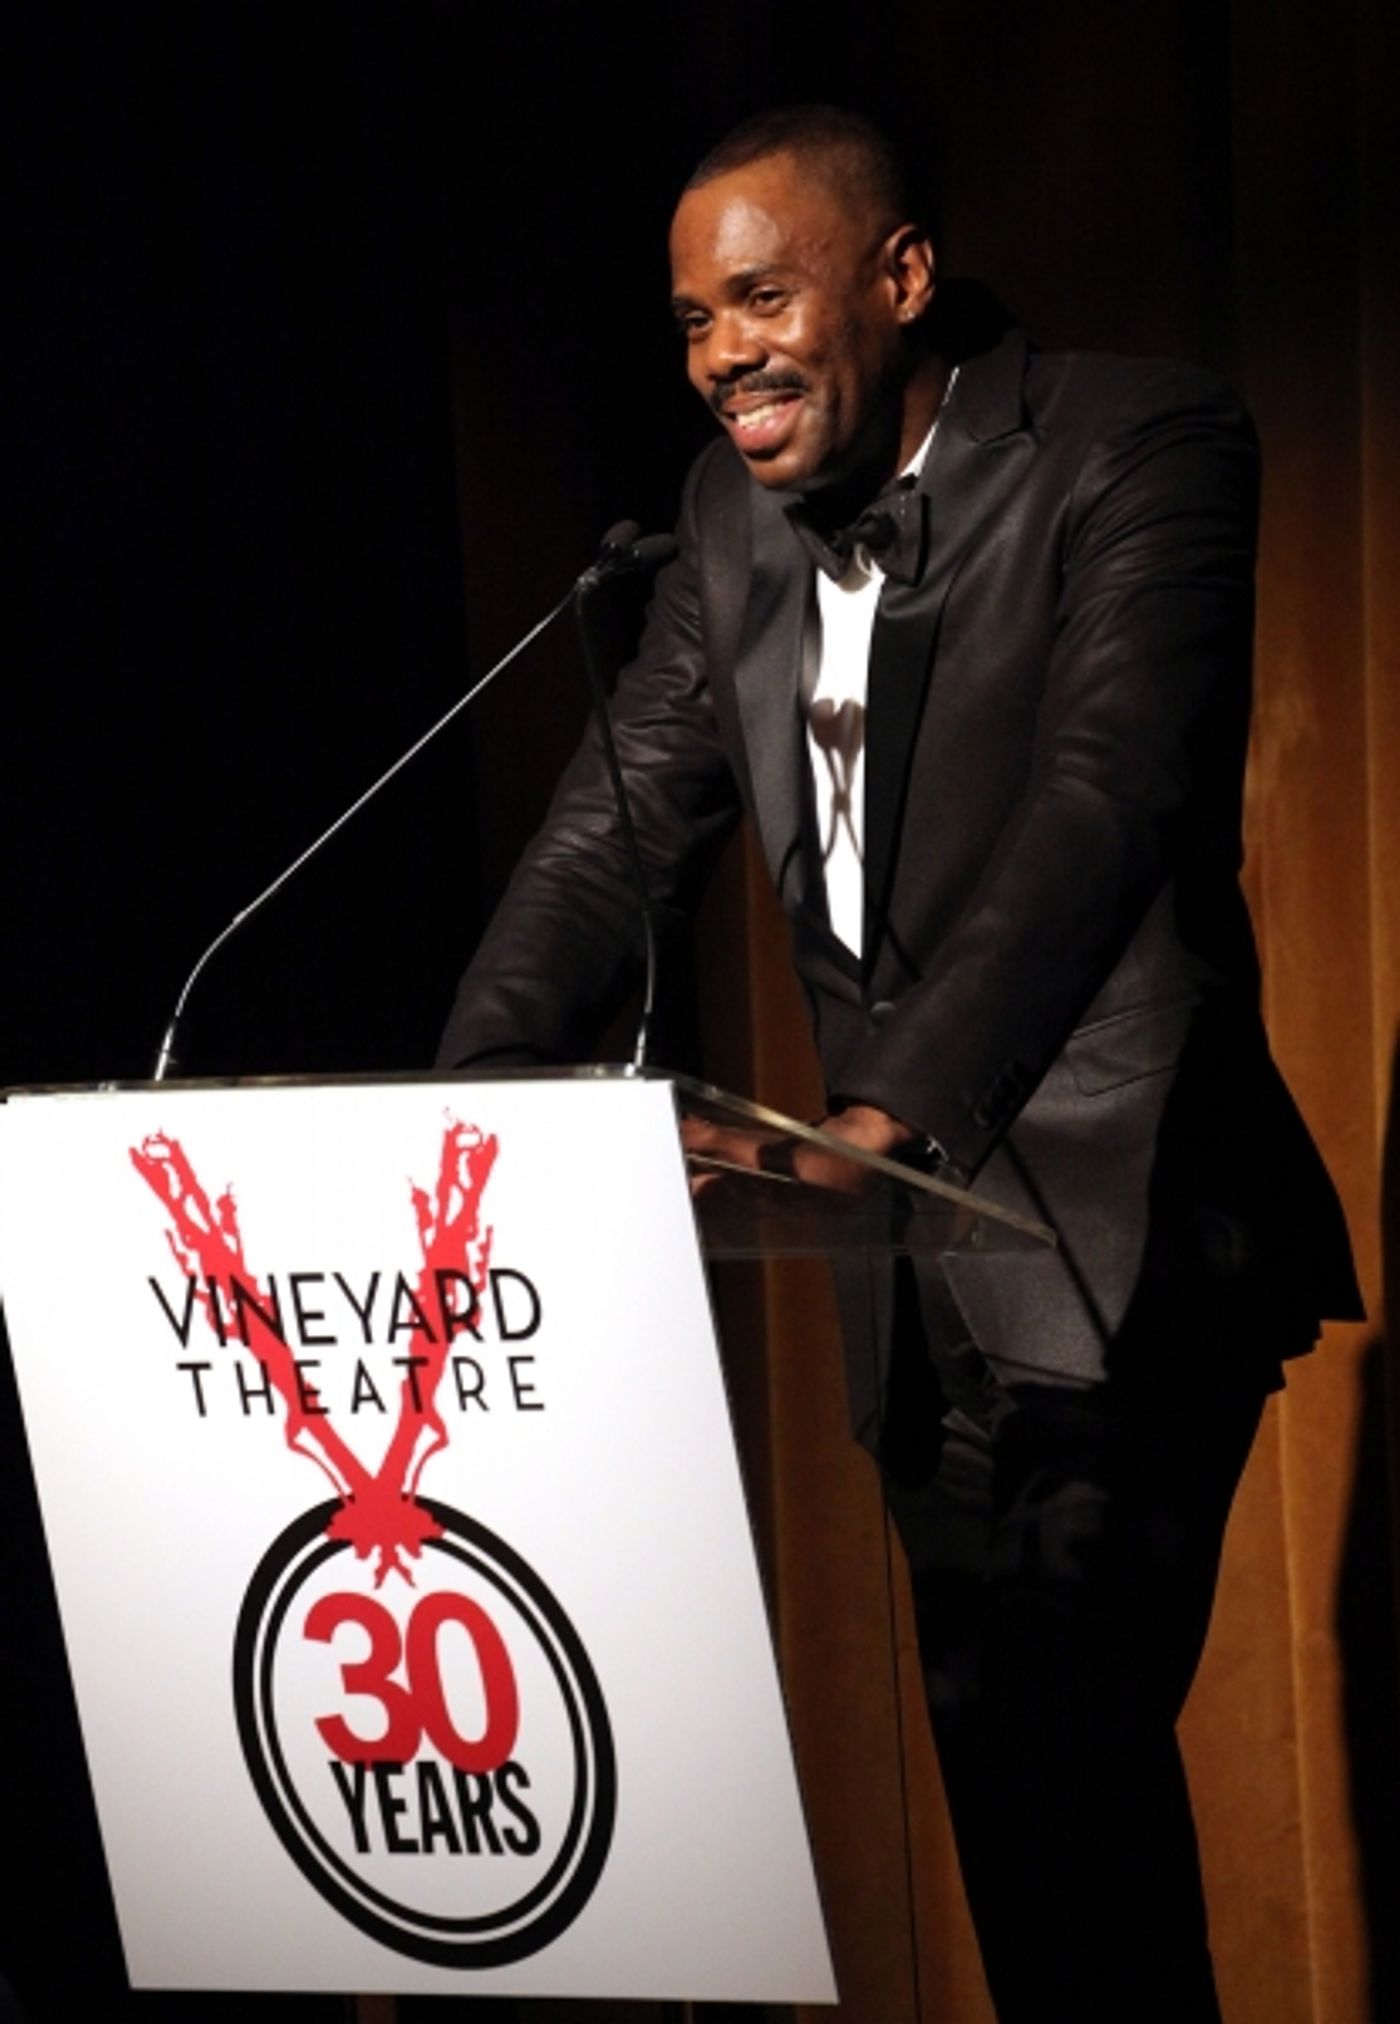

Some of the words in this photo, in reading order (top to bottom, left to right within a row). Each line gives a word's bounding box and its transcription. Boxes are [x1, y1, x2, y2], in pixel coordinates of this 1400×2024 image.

[148, 1268, 542, 1349] VINEYARD
[176, 1356, 545, 1417] THEATRE
[303, 1590, 520, 1775] 30
[328, 1760, 541, 1857] YEARS
